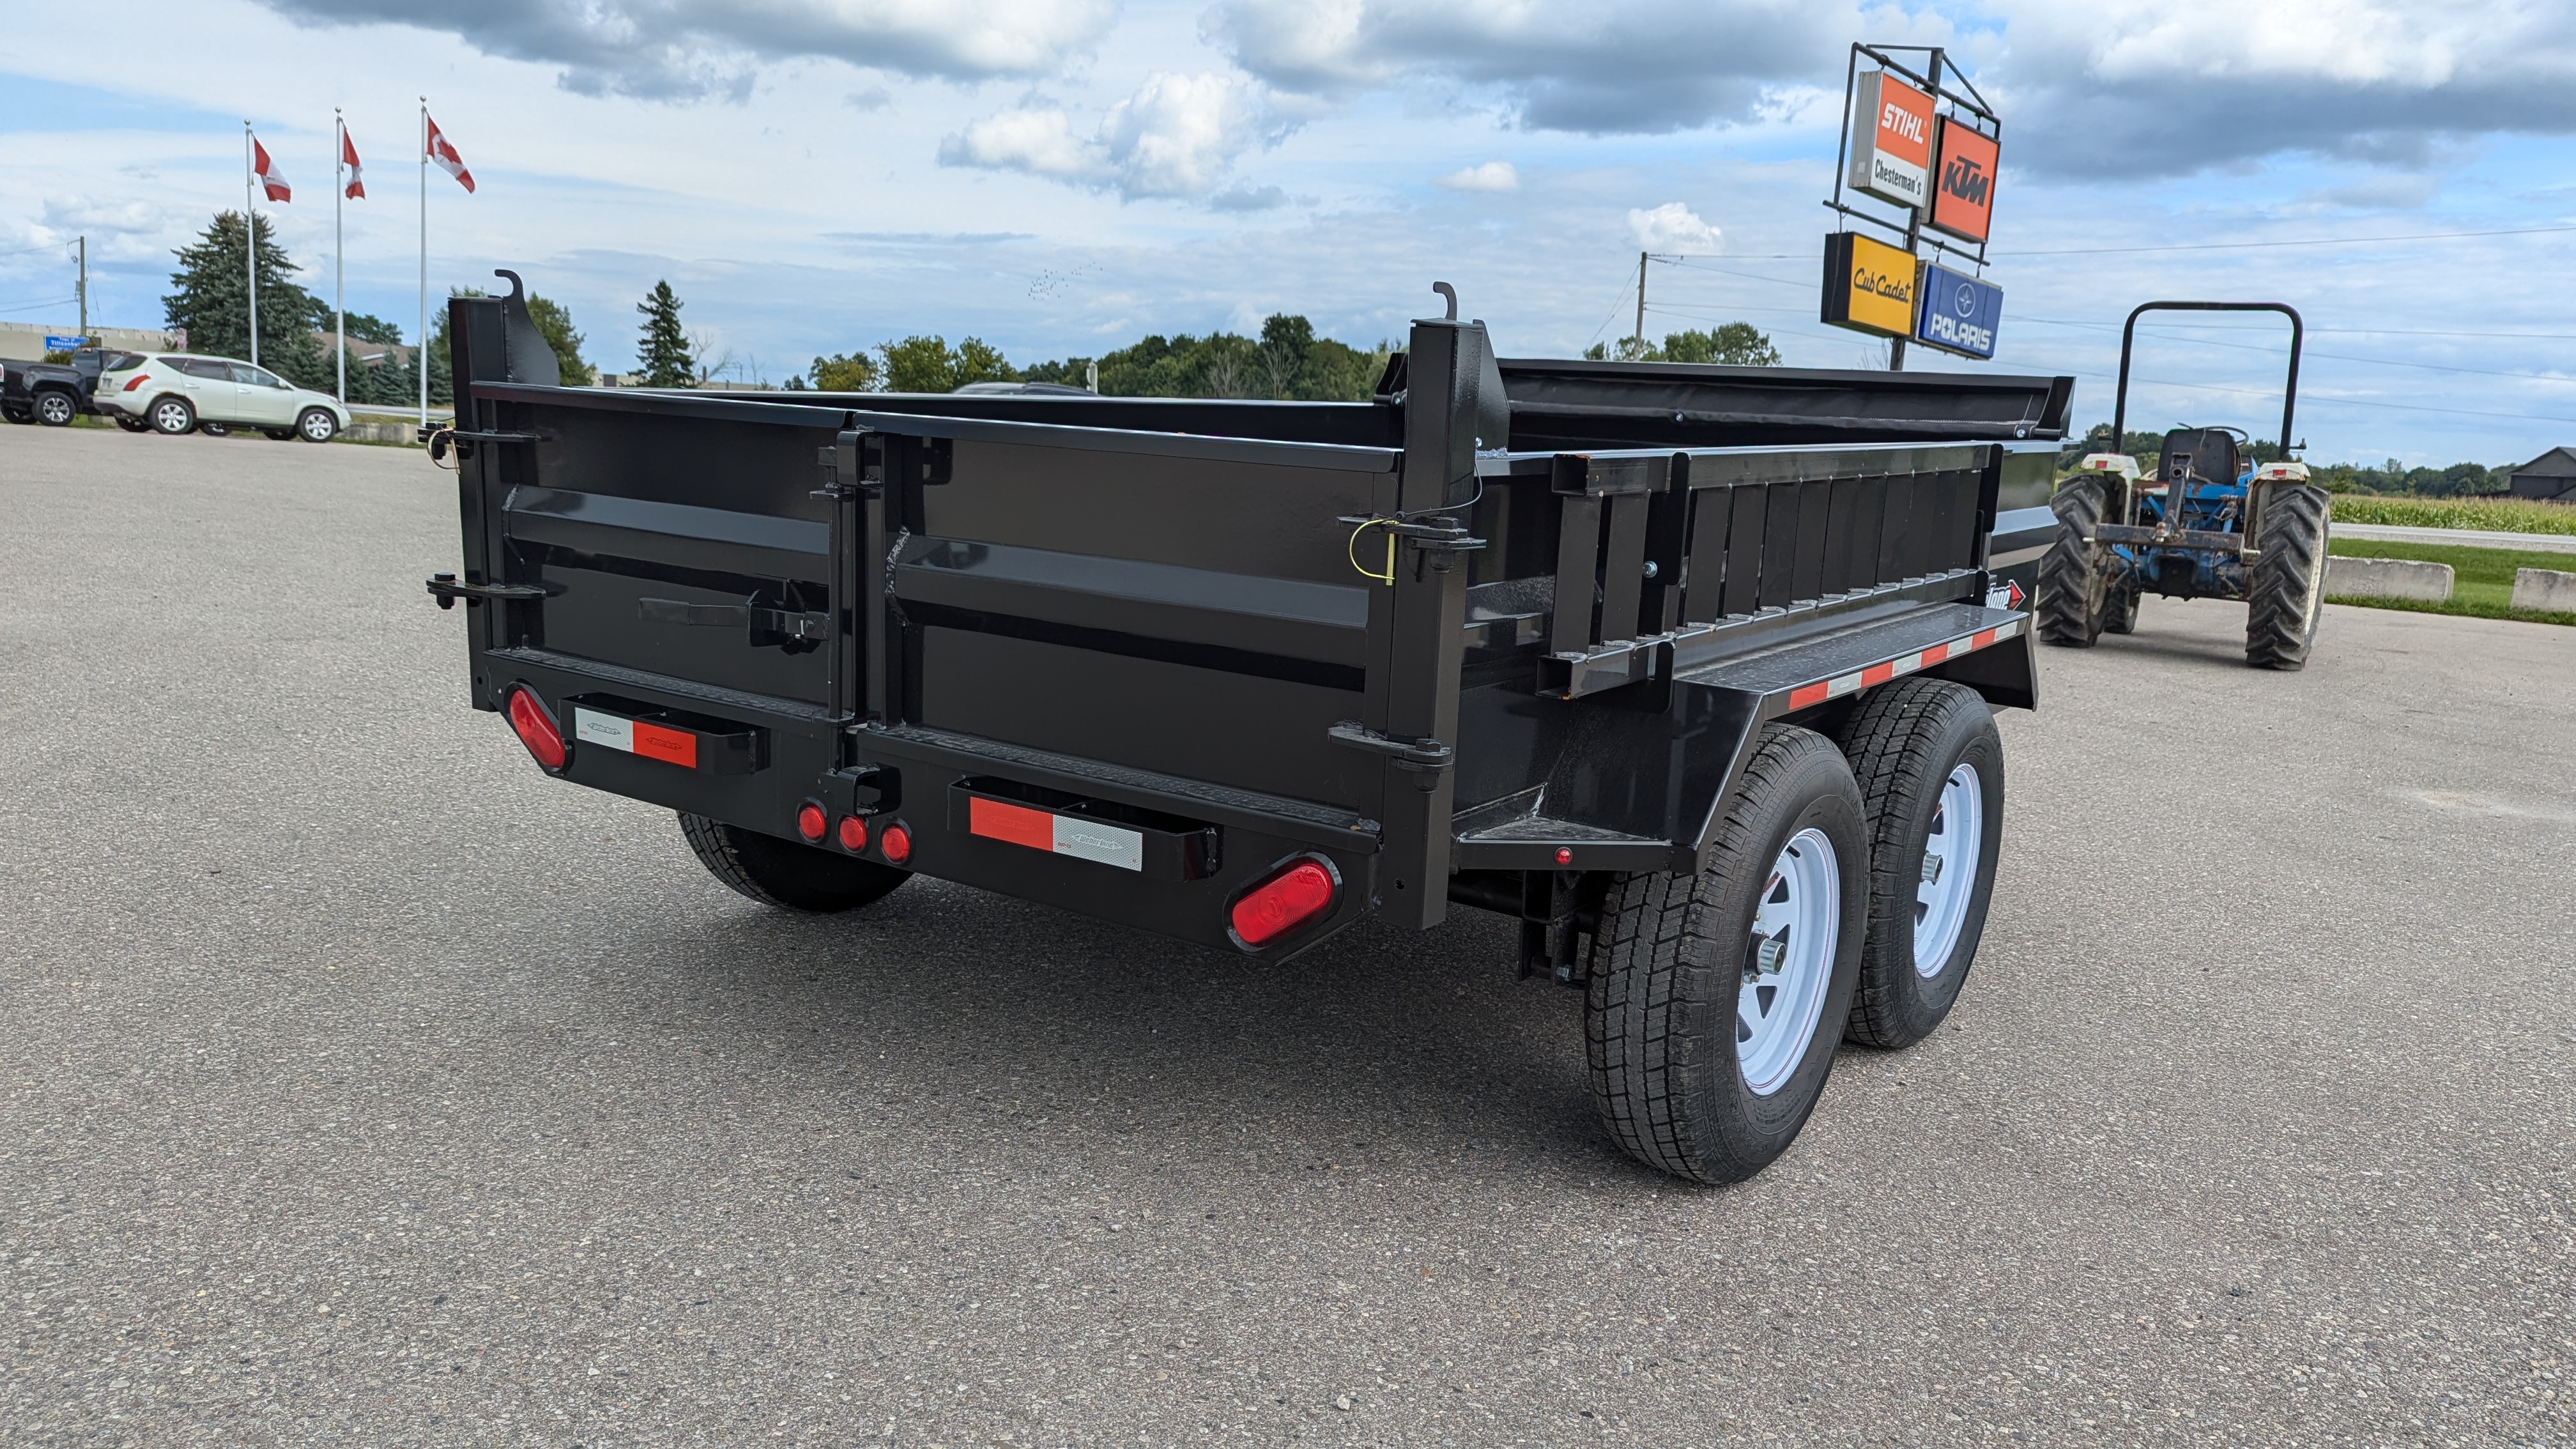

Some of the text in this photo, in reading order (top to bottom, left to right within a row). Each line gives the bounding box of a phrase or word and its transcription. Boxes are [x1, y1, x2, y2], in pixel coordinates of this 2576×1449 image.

[1882, 103, 1923, 144] STIHL
[1875, 158, 1921, 195] Chesterman's
[1942, 155, 1989, 208] KTM
[1853, 267, 1911, 303] Cub Cadet
[1931, 313, 1991, 351] POLARIS
